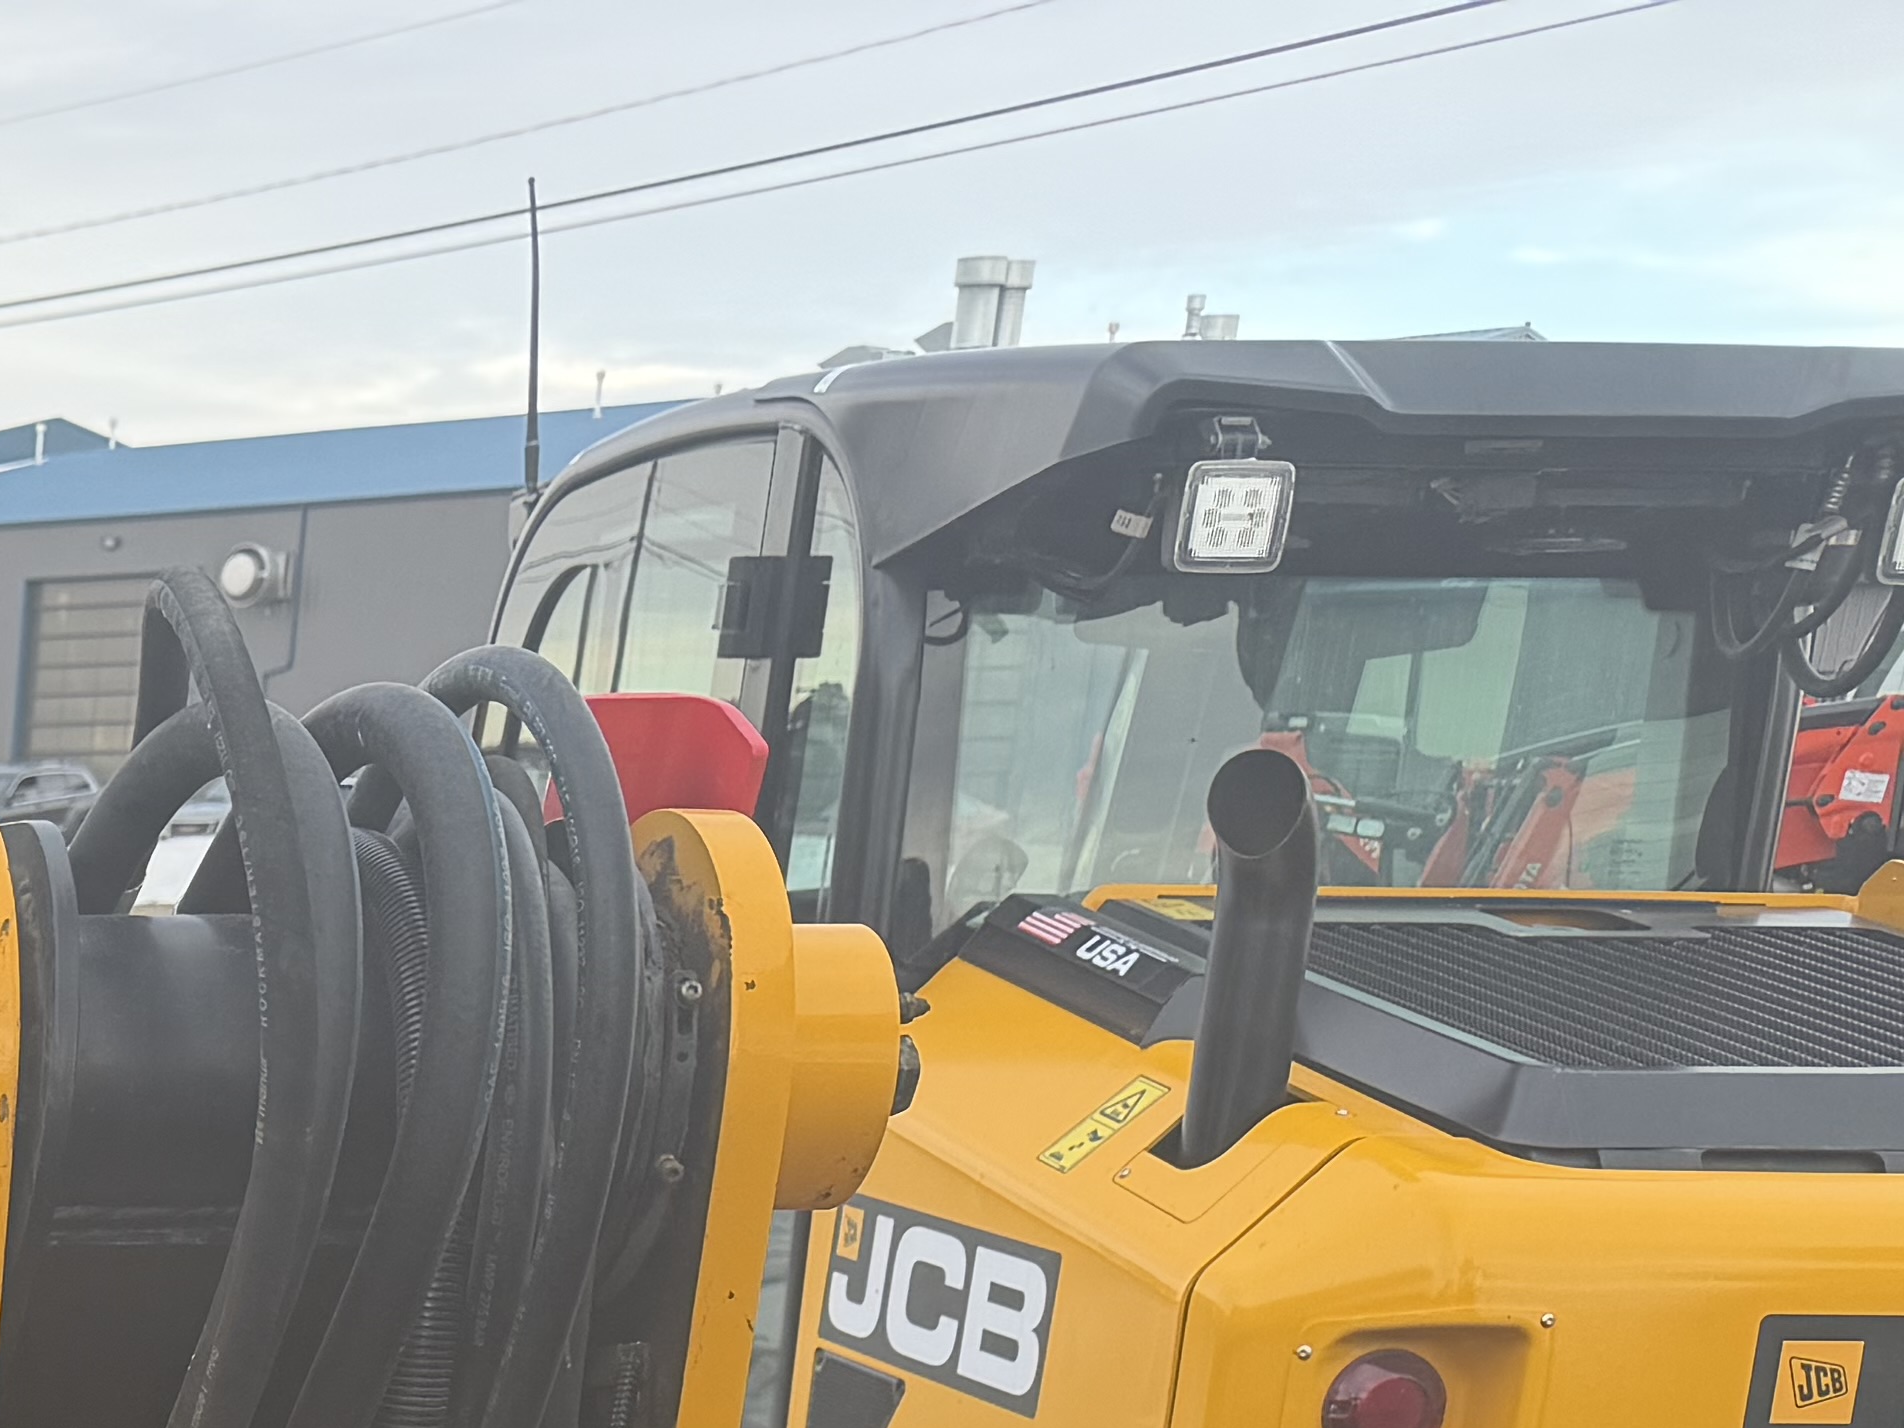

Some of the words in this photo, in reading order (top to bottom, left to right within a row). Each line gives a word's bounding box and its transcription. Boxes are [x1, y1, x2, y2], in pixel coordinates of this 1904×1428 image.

[1076, 934, 1140, 977] USA
[828, 1214, 1047, 1396] JCB
[1797, 1362, 1844, 1402] JCB
